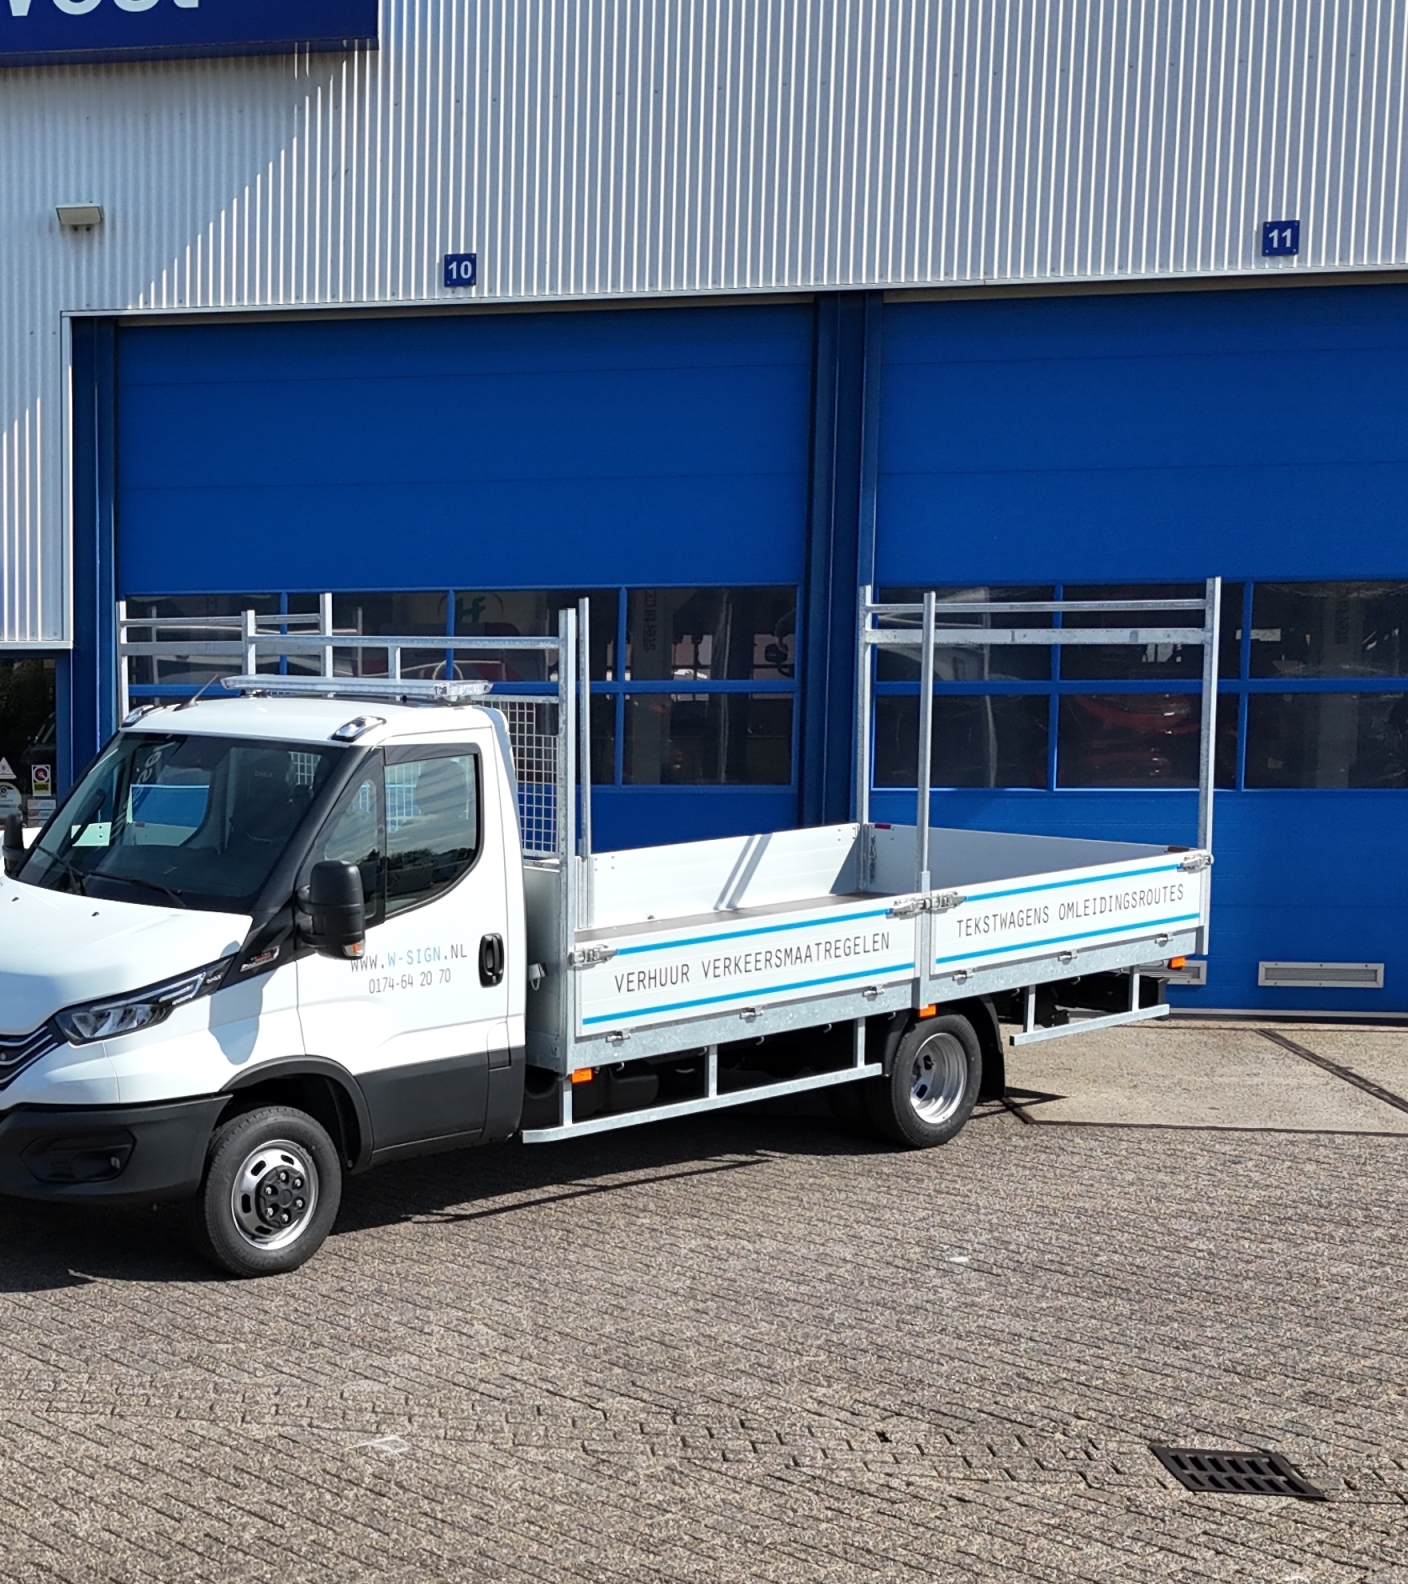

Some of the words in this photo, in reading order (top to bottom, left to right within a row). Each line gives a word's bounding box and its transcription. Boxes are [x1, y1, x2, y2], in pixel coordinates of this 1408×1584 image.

[1268, 228, 1292, 249] 11
[448, 260, 473, 280] 10
[956, 905, 1050, 938] TEKSTWAGENS
[1058, 883, 1184, 921] OMLEIDINGSROUTES
[350, 943, 468, 973] WWW.W-SIGN.NL
[614, 963, 690, 994] VERHUUR
[701, 931, 890, 979] VERKEERSMAATREGELEN
[368, 973, 414, 994] 0174-64
[420, 970, 432, 987] 20
[439, 967, 451, 984] 70
